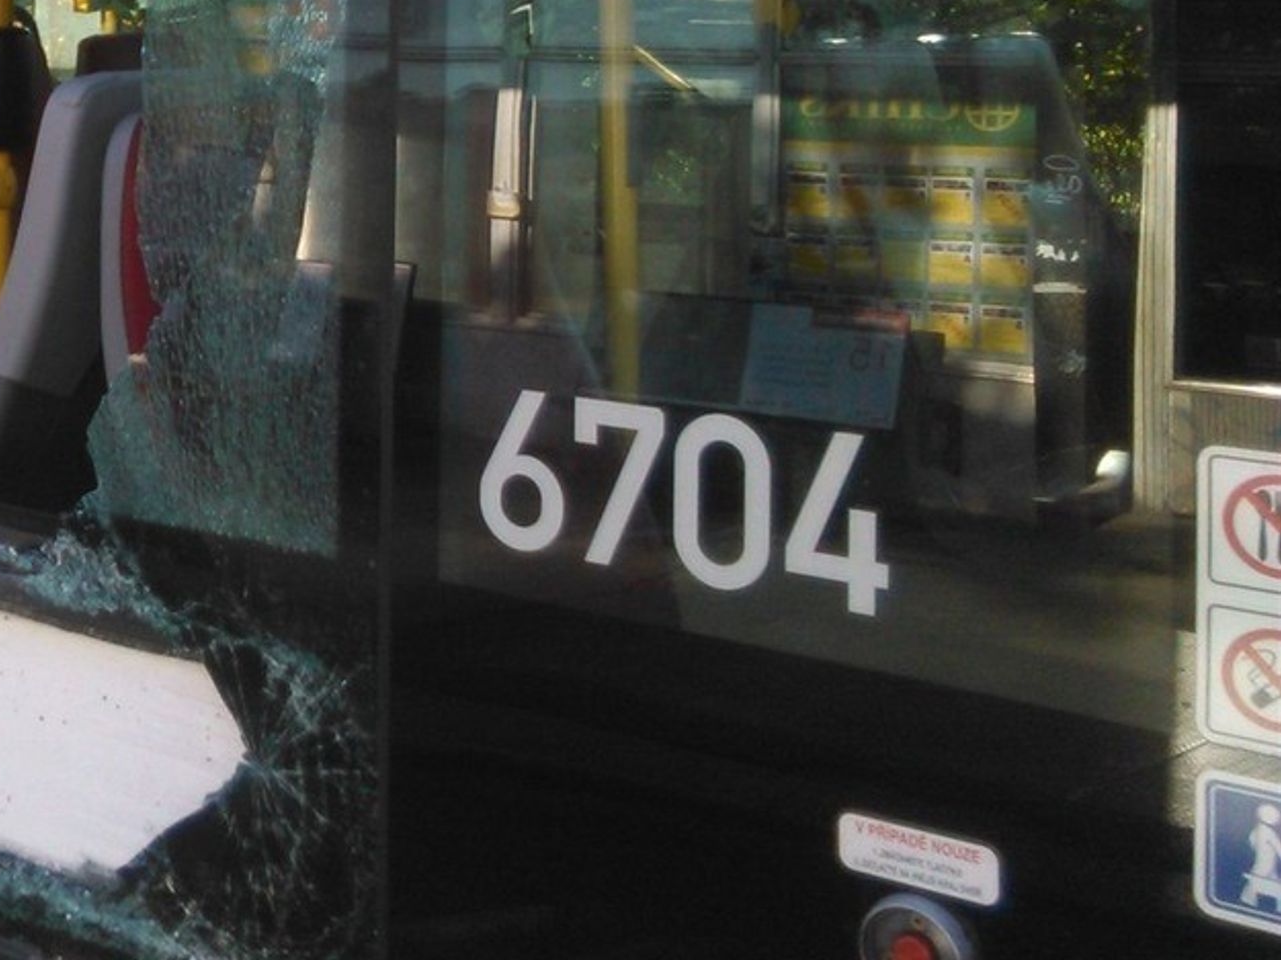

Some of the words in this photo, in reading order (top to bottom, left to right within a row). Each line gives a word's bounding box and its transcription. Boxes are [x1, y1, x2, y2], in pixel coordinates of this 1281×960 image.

[479, 389, 890, 617] 6704
[855, 820, 866, 835] V
[930, 842, 982, 865] NOUZE
